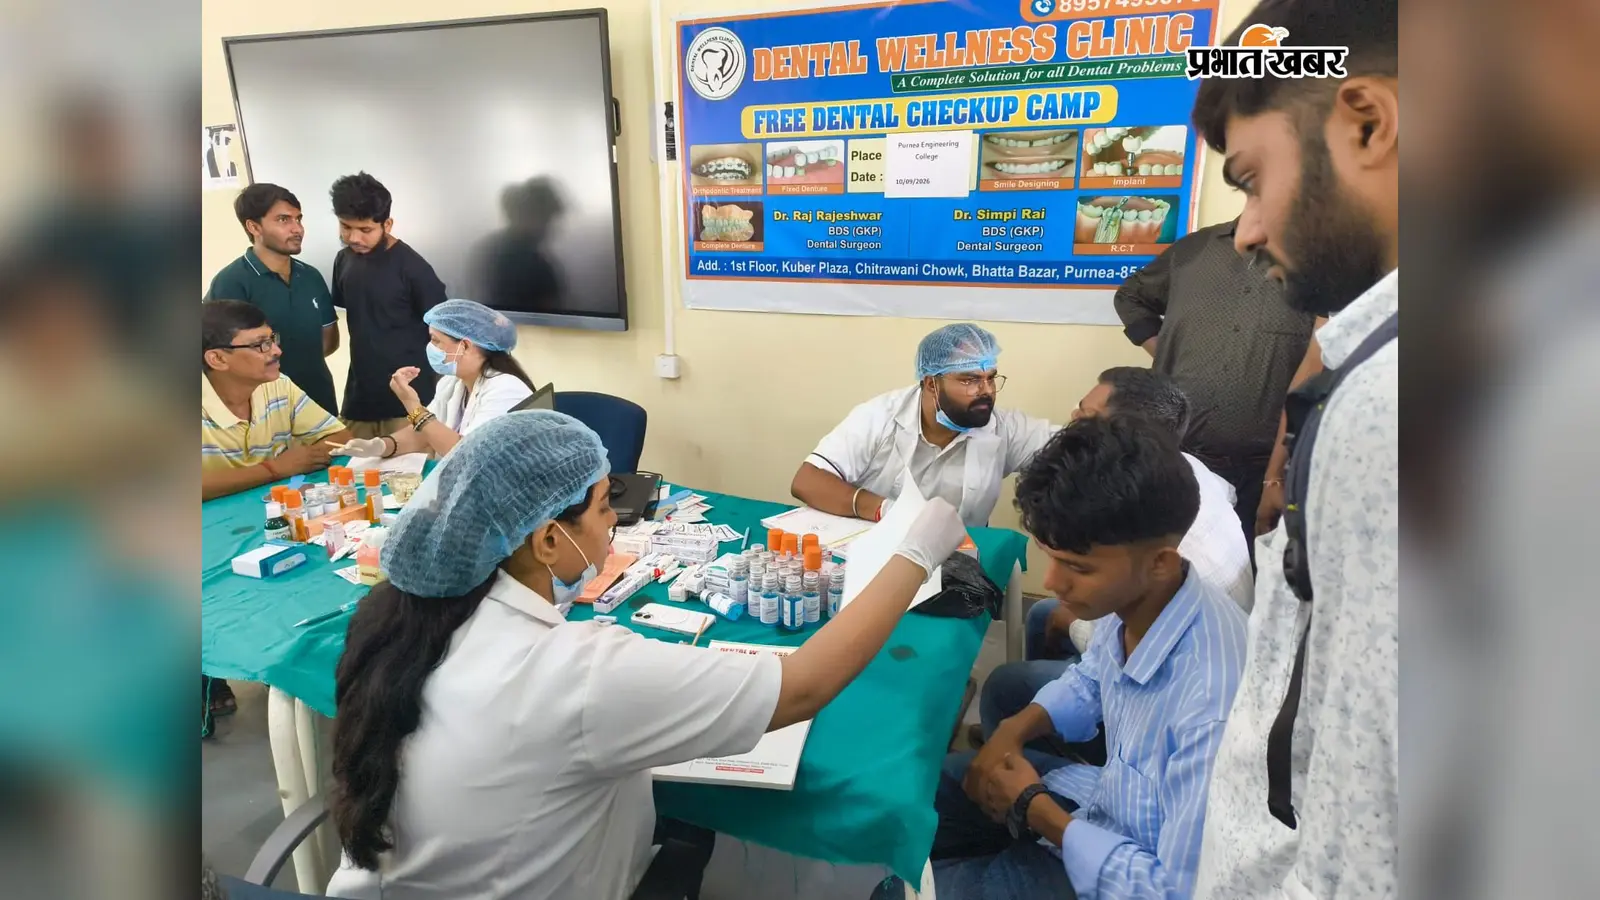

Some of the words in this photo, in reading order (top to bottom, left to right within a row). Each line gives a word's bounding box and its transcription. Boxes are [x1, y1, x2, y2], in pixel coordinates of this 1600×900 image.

[753, 40, 868, 82] DENTAL
[876, 23, 1056, 72] WELLNESS
[1066, 13, 1194, 59] CLINIC
[690, 53, 698, 72] DENTAL
[697, 36, 718, 52] WELLNESS
[719, 36, 734, 44] CLINIC
[897, 77, 906, 88] A
[910, 73, 965, 89] Complete
[968, 70, 1020, 83] Solution
[1024, 67, 1046, 83] for
[1046, 65, 1064, 79] all
[1067, 63, 1114, 78] Dental
[1116, 60, 1182, 75] Problems
[753, 108, 806, 135] FREE
[812, 103, 899, 133] DENTAL
[906, 94, 1019, 128] CHECKUP
[1026, 91, 1101, 121] CAMP
[921, 140, 959, 149] Engineering
[851, 150, 882, 161] Place
[915, 153, 938, 161] College
[851, 171, 876, 182] Date
[1113, 177, 1146, 188] Implant
[993, 181, 1016, 189] Smile
[1018, 179, 1060, 190] Designing
[773, 211, 789, 221] Dr.
[793, 211, 813, 223] Raj
[816, 210, 882, 223] Rajeshwar
[953, 209, 972, 220] Dr.
[977, 208, 1017, 222] Simpi
[1021, 208, 1047, 219] Rai
[828, 227, 849, 236] BDS
[852, 226, 882, 237] (GKP)
[982, 227, 1007, 236] BDS
[1009, 226, 1044, 238] (GKP)
[701, 242, 730, 250] Complete
[807, 239, 837, 249] Dental
[840, 240, 882, 251] Surgeon
[957, 241, 992, 251] Dental
[995, 241, 1043, 253] Surgeon
[697, 260, 721, 271] Add.
[730, 261, 747, 271] 1st
[749, 261, 779, 274] Floor,
[782, 262, 815, 273] Kuber
[819, 263, 851, 276] Plaza,
[855, 263, 919, 275] Chitrawani
[922, 264, 968, 279] Chowk,
[972, 264, 1014, 277] Bhatta
[1018, 265, 1060, 280] Bazar,
[1064, 265, 1147, 279] Purnea-85
